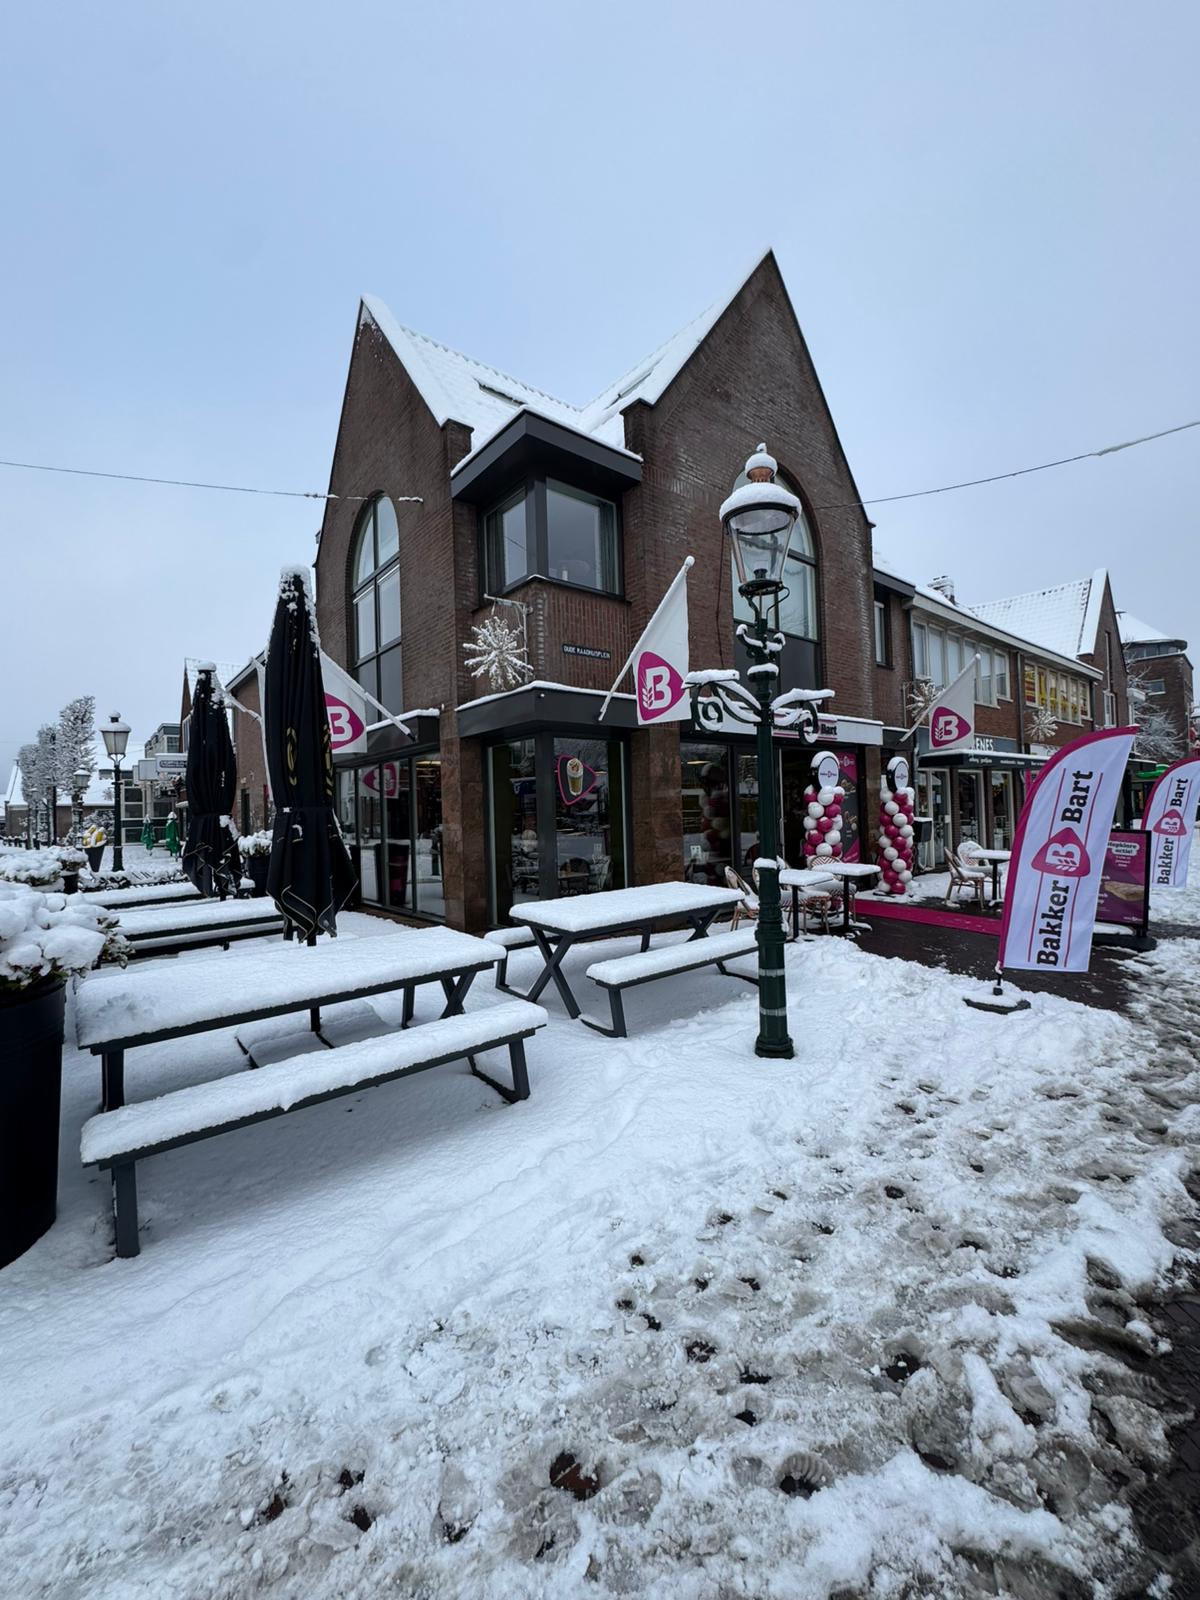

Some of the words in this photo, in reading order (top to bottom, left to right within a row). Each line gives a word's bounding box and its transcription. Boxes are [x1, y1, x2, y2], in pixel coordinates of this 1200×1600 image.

[1036, 880, 1070, 967] Bakker
[1061, 770, 1093, 824] Bart
[1156, 838, 1175, 885] Bakker
[1169, 778, 1189, 808] Bart
